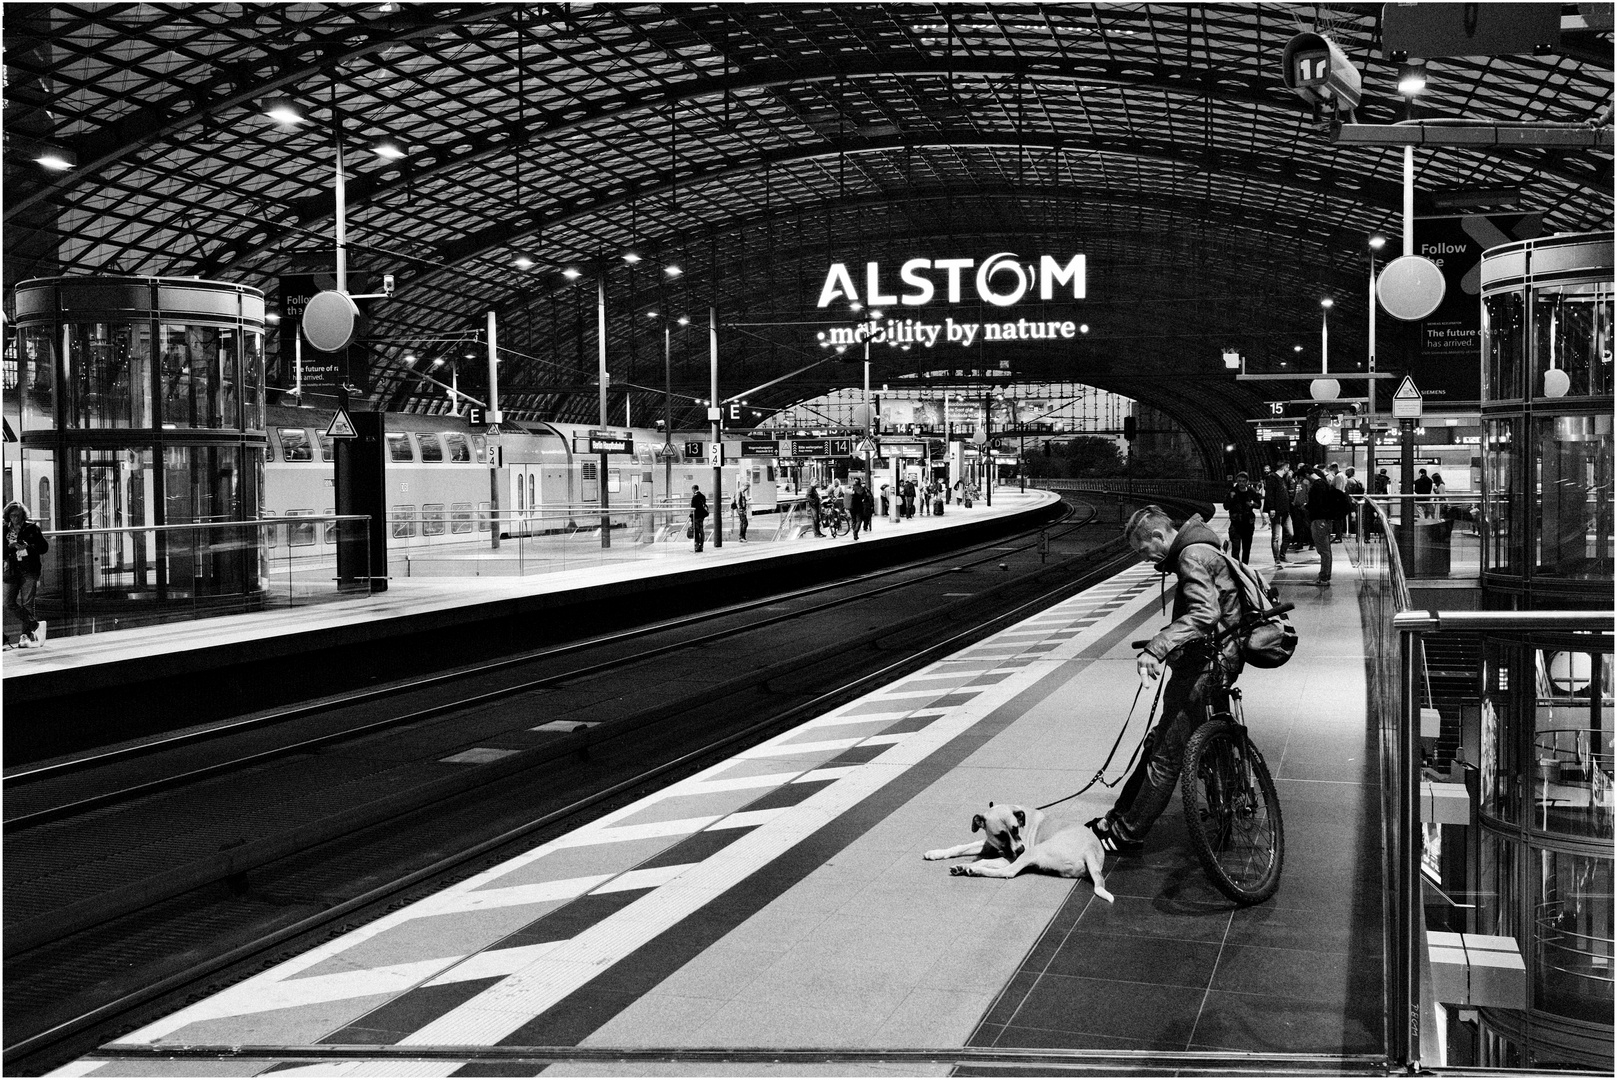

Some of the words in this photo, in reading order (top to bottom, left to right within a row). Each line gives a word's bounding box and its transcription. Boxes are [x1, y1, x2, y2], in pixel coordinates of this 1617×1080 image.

[1421, 242, 1467, 254] Follow
[816, 252, 1087, 308] ALSTOM
[287, 295, 312, 305] Follo
[829, 318, 942, 348] mobility
[946, 317, 979, 347] by
[984, 318, 1076, 340] nature
[1427, 329, 1445, 338] The
[1446, 328, 1476, 337] future
[1427, 339, 1442, 348] has
[1443, 338, 1475, 347] arrived.
[305, 365, 326, 373] future
[326, 364, 333, 372] of
[731, 404, 740, 420] E
[1269, 402, 1284, 415] 15
[470, 409, 480, 424] E
[895, 424, 906, 433] 14
[489, 446, 495, 456] 5
[687, 443, 699, 455] 13
[712, 444, 718, 454] 5
[834, 440, 848, 453] 14
[489, 456, 495, 465] 4
[712, 455, 718, 464] 4
